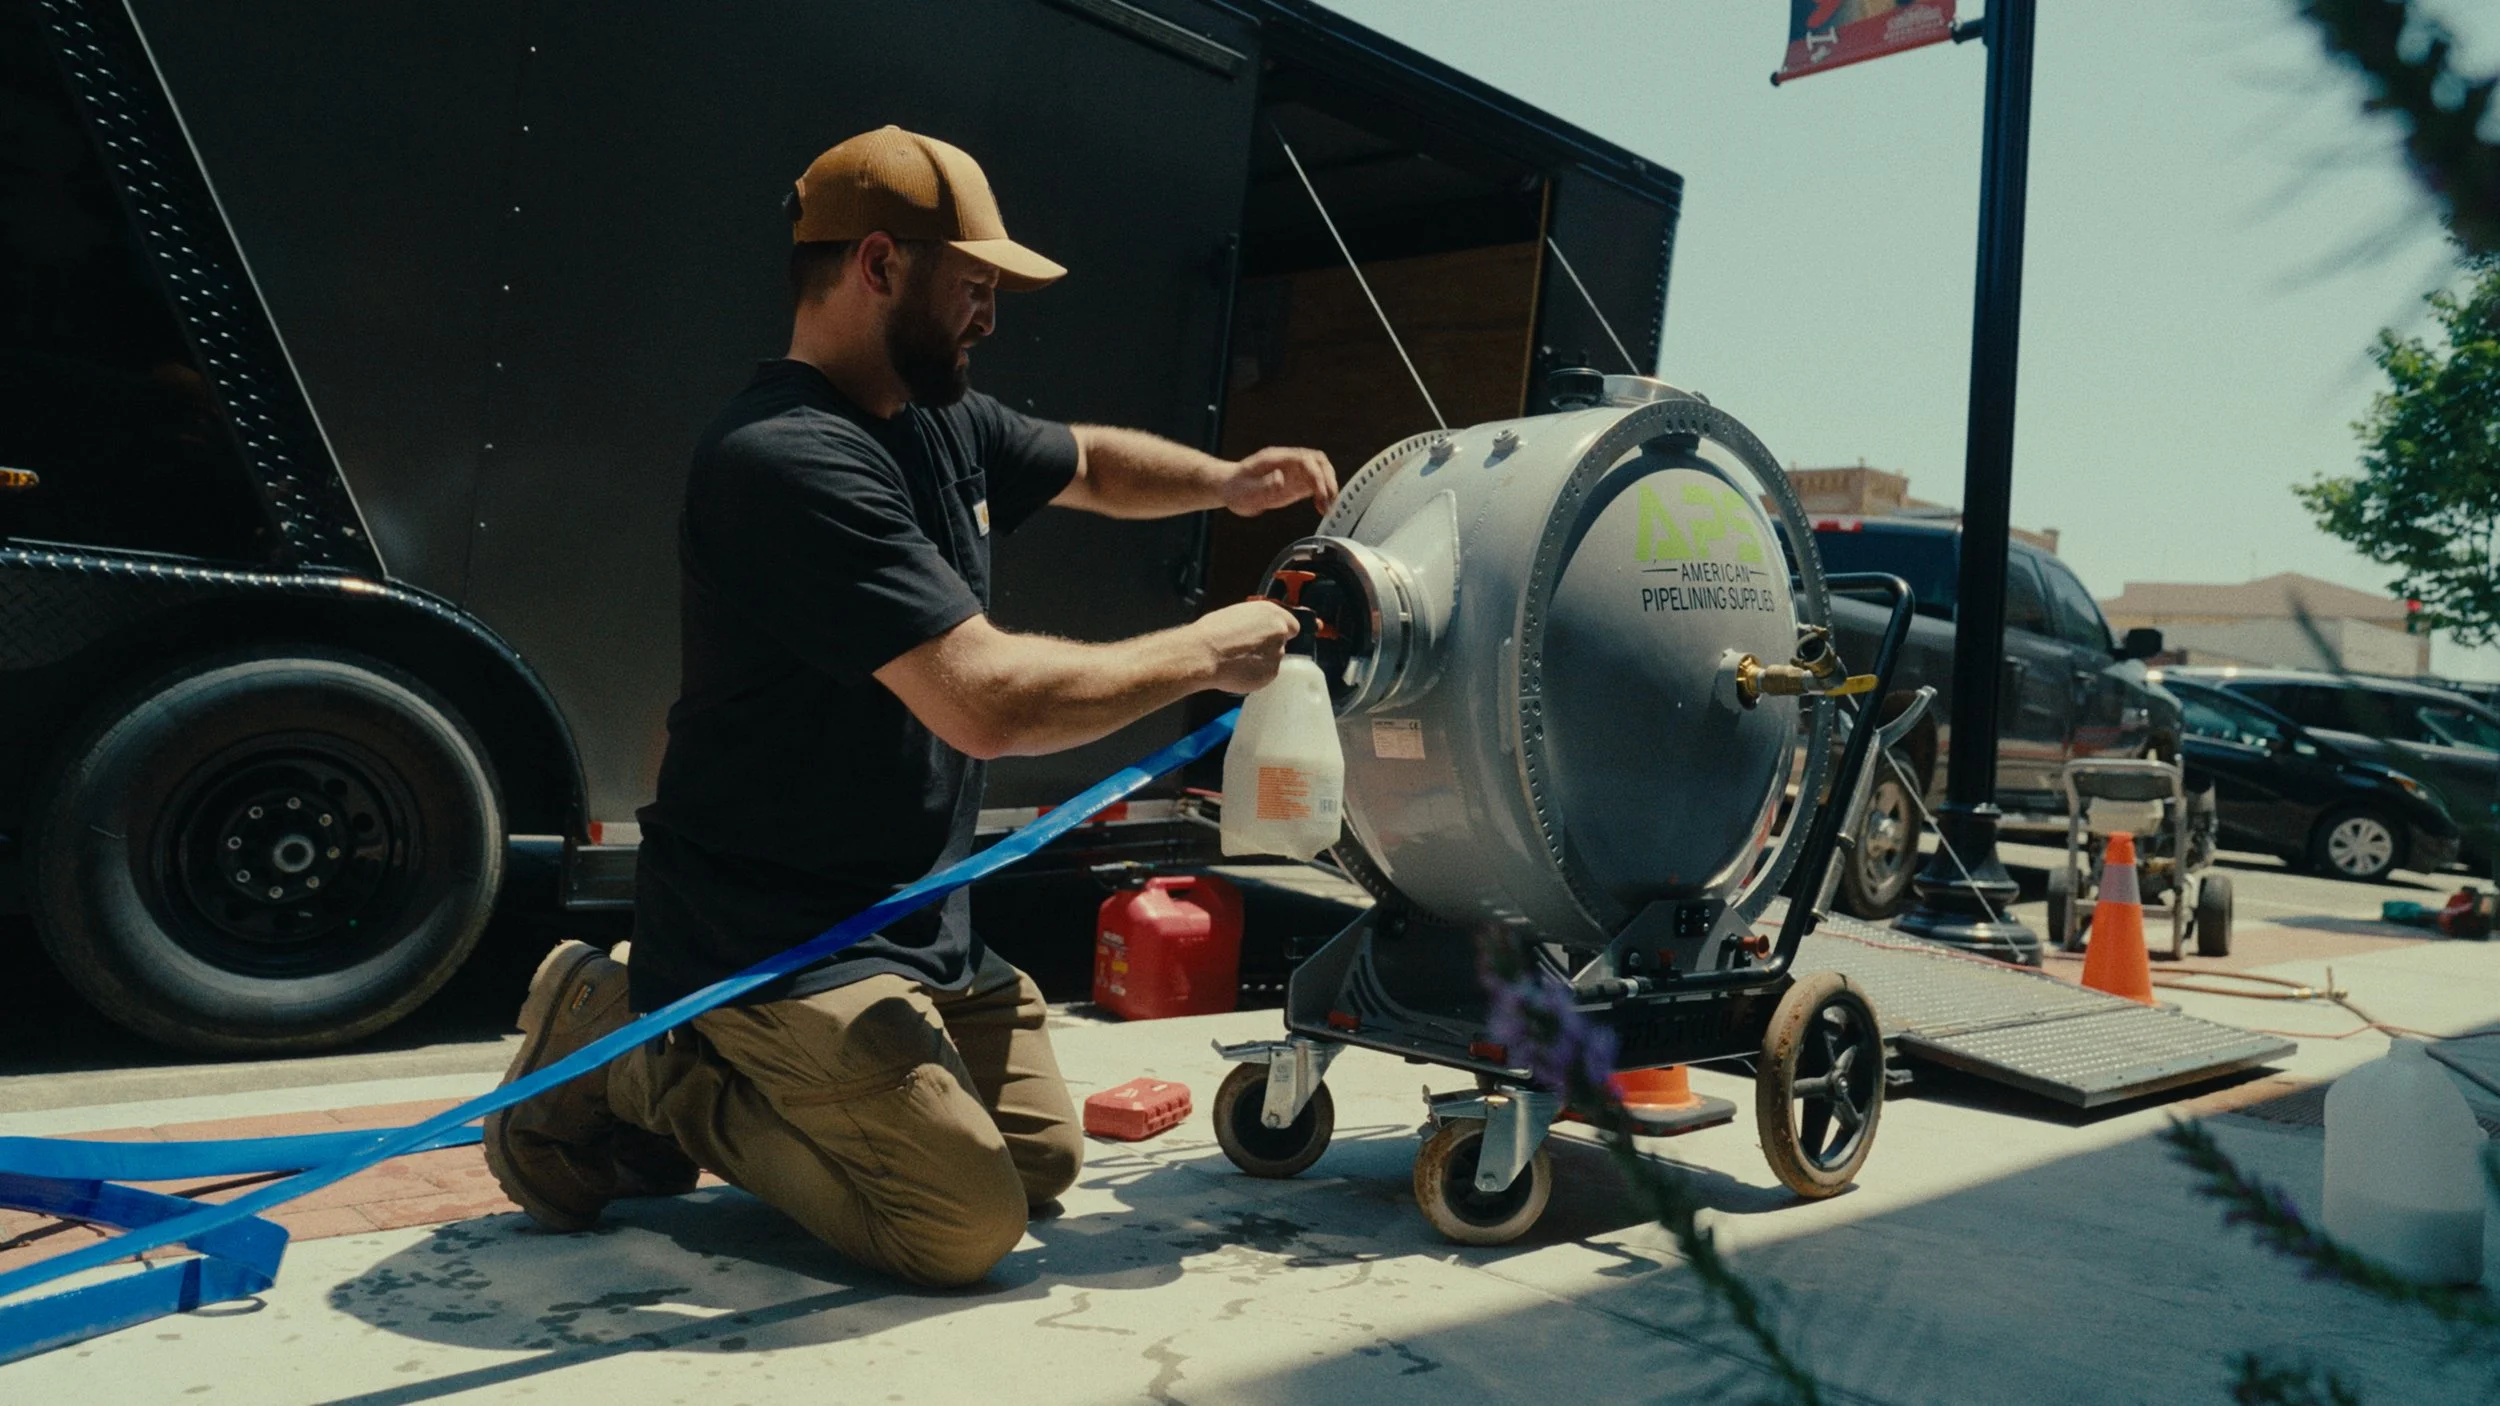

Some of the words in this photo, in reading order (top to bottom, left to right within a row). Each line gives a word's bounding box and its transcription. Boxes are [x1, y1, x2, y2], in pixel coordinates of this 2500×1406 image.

[1635, 484, 1763, 562] APS
[1682, 563, 1750, 583] AMERICAN
[1642, 587, 1727, 612] PIPELINING
[1728, 587, 1775, 612] SUPPLIES
